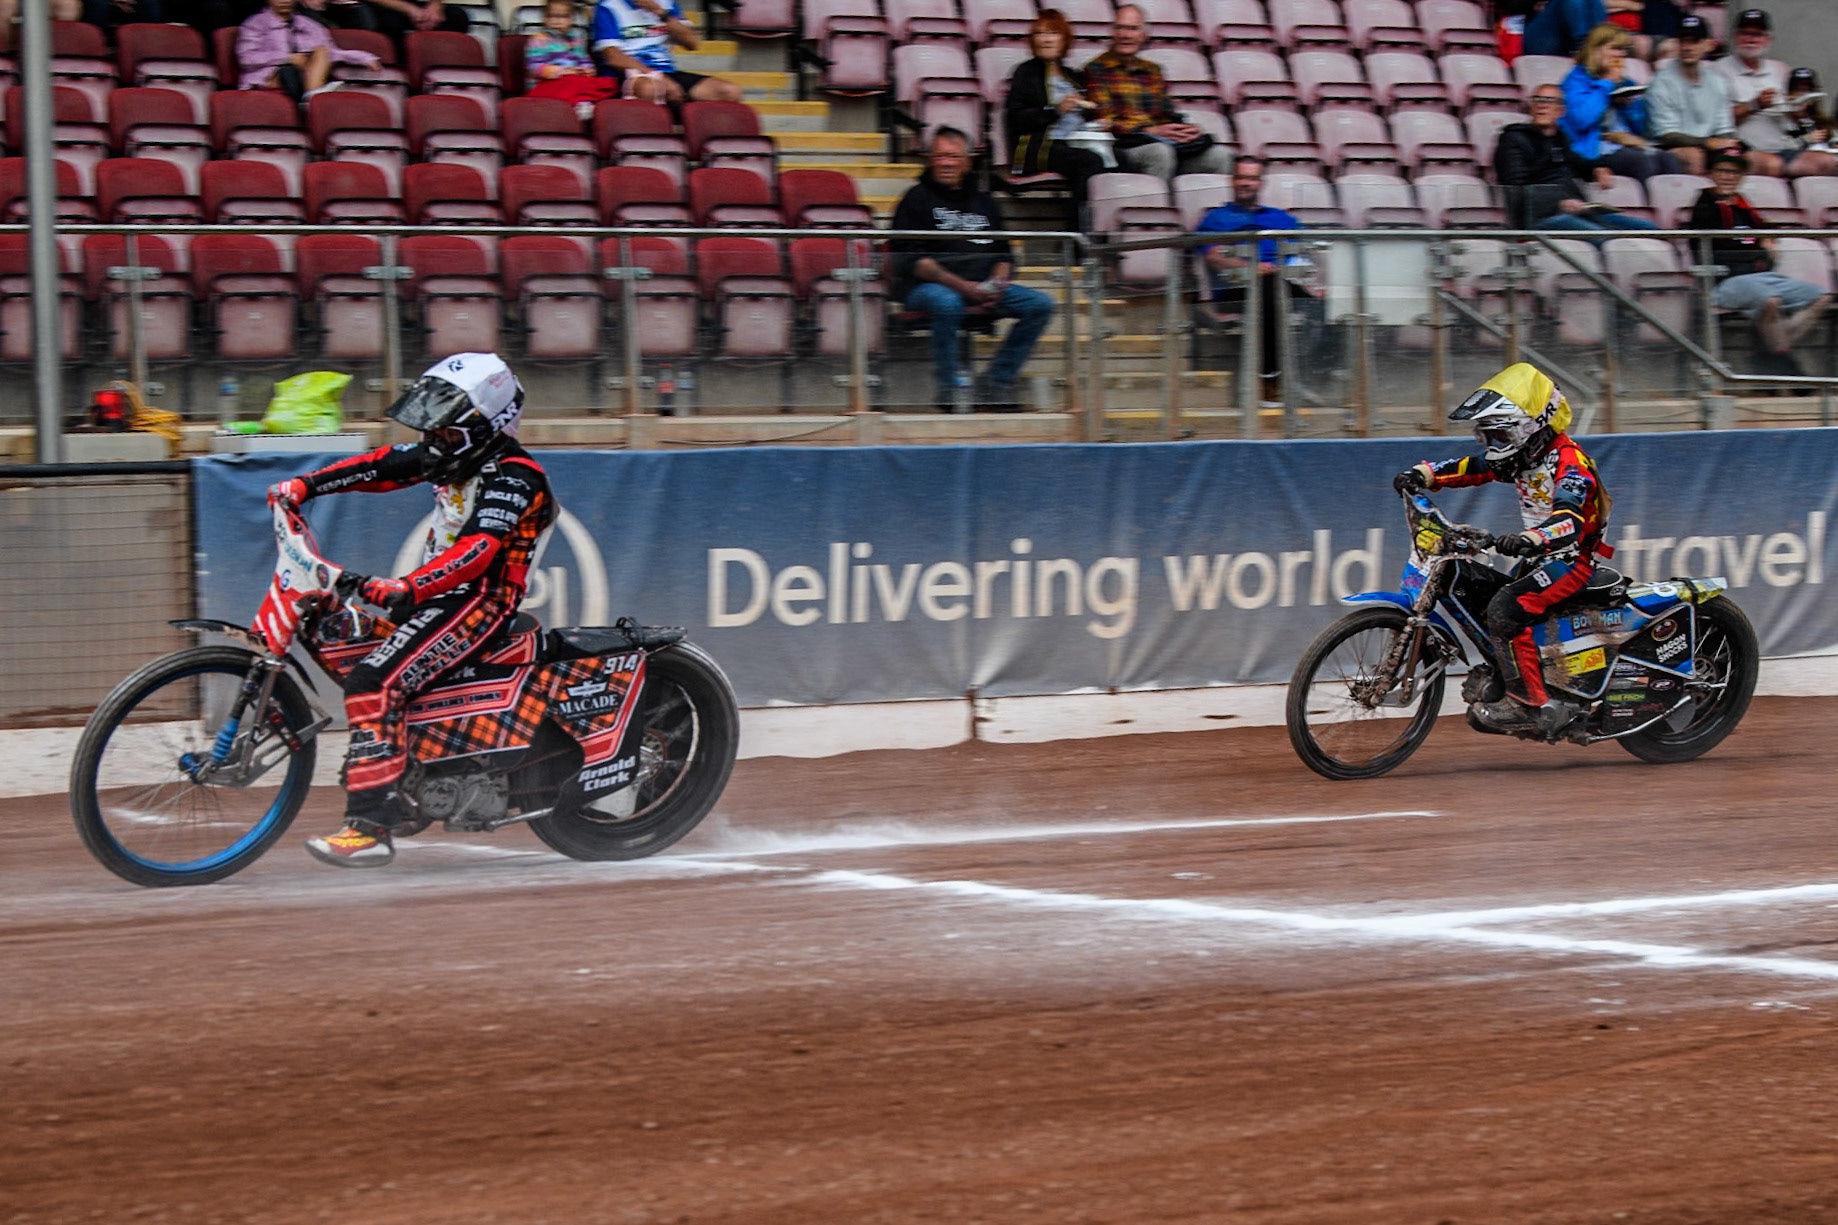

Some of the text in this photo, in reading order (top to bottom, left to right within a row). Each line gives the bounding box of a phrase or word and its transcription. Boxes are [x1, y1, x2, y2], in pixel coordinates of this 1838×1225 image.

[707, 511, 1826, 639] Delivering world travel
[1572, 612, 1622, 629] BOMAN
[401, 632, 457, 683] AUNTIE
[1658, 641, 1688, 663] SHOCKS
[603, 654, 638, 675] 914
[559, 694, 620, 714] MACADE
[578, 755, 636, 782] Arnold
[583, 771, 630, 791] Clark
